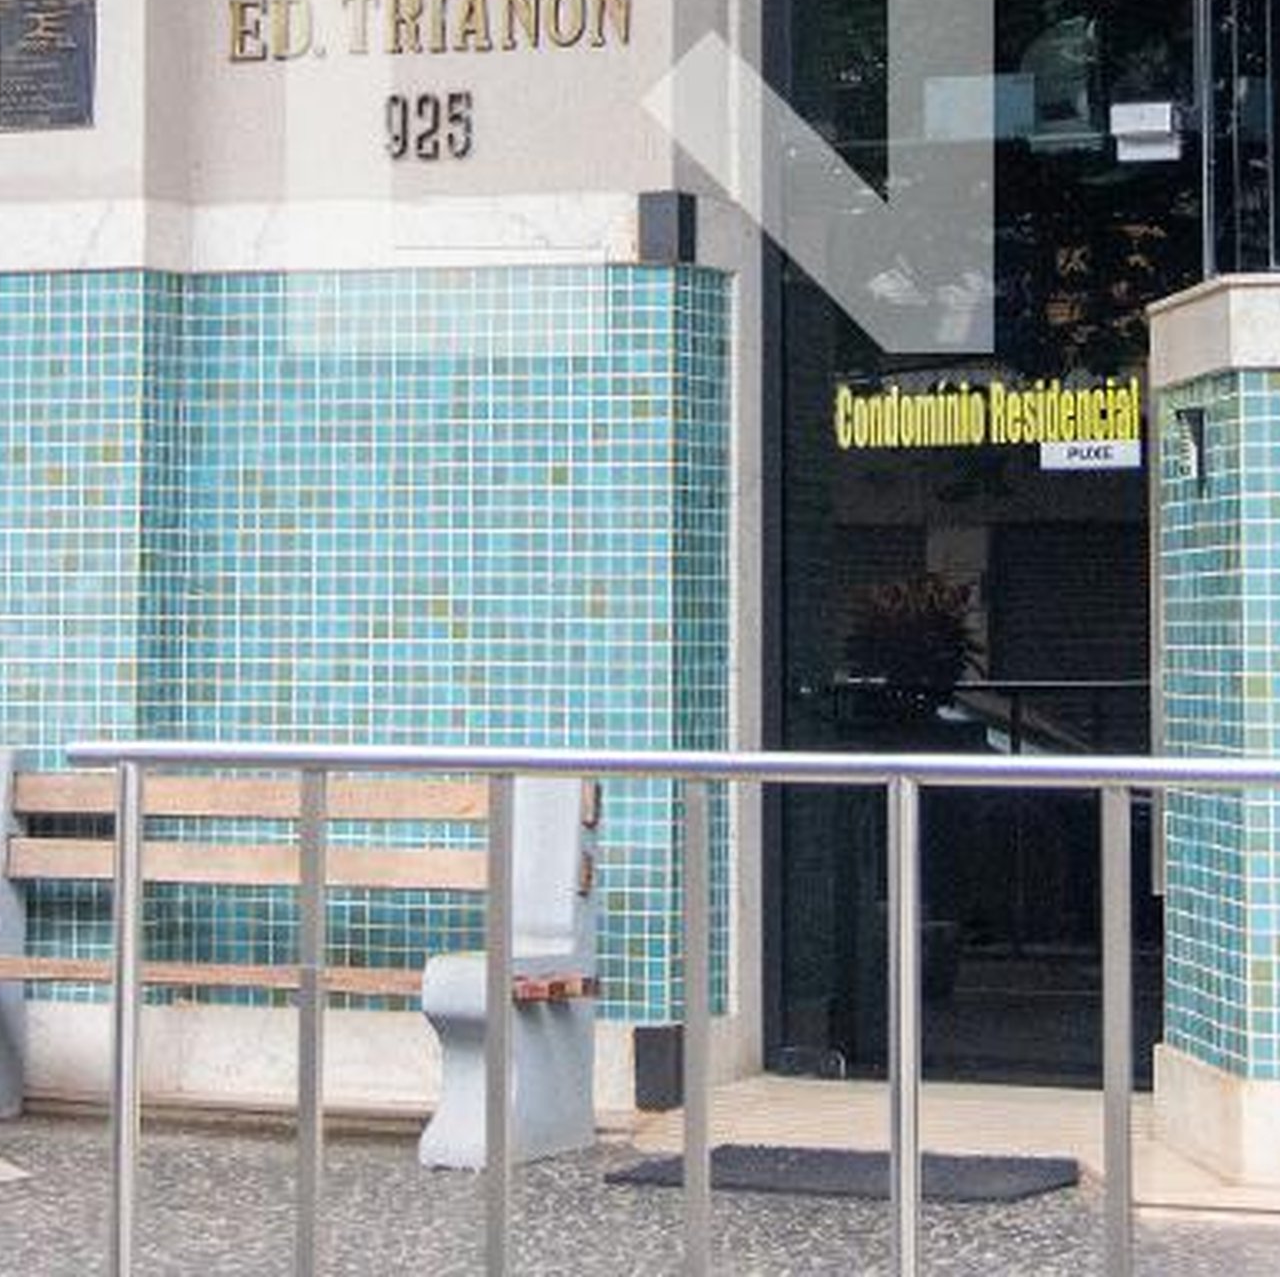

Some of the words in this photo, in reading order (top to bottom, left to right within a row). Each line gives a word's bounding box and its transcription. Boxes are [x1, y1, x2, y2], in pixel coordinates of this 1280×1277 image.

[386, 91, 474, 162] 925
[834, 377, 986, 450] Condomínio
[989, 375, 1140, 444] Residencial
